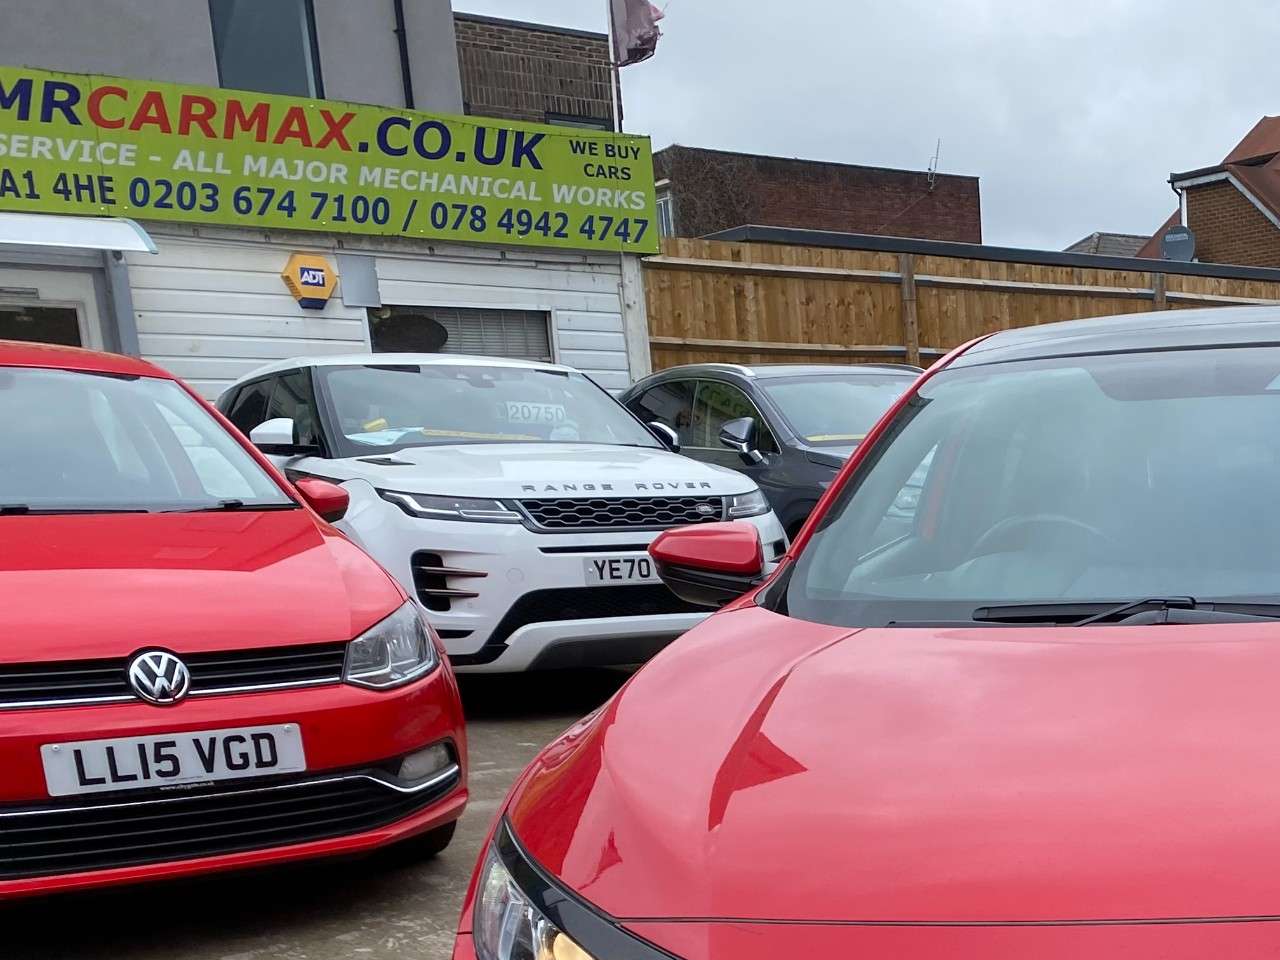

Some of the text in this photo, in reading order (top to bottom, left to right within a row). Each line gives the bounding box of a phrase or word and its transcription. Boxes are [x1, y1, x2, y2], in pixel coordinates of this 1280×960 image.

[0, 78, 547, 170] MRCARMAX.CO.UK
[569, 139, 641, 161] WE BUY
[172, 150, 232, 174] ALL
[243, 155, 348, 185] MAJOR
[359, 166, 542, 201] MECHANICAL
[552, 183, 646, 210] WORKS
[583, 163, 632, 181] CARS
[52, 172, 117, 205] 4HE
[129, 177, 219, 212] 0203
[233, 186, 296, 218] 674
[310, 192, 390, 226] 7100
[402, 199, 418, 232] /
[430, 202, 487, 232] 078
[497, 208, 568, 238] 4942
[579, 215, 648, 244] 4747
[301, 270, 325, 285] ADT
[521, 481, 712, 492] RANGE ROVER
[593, 558, 650, 580] YE70
[73, 732, 278, 786] LL15 VGD
